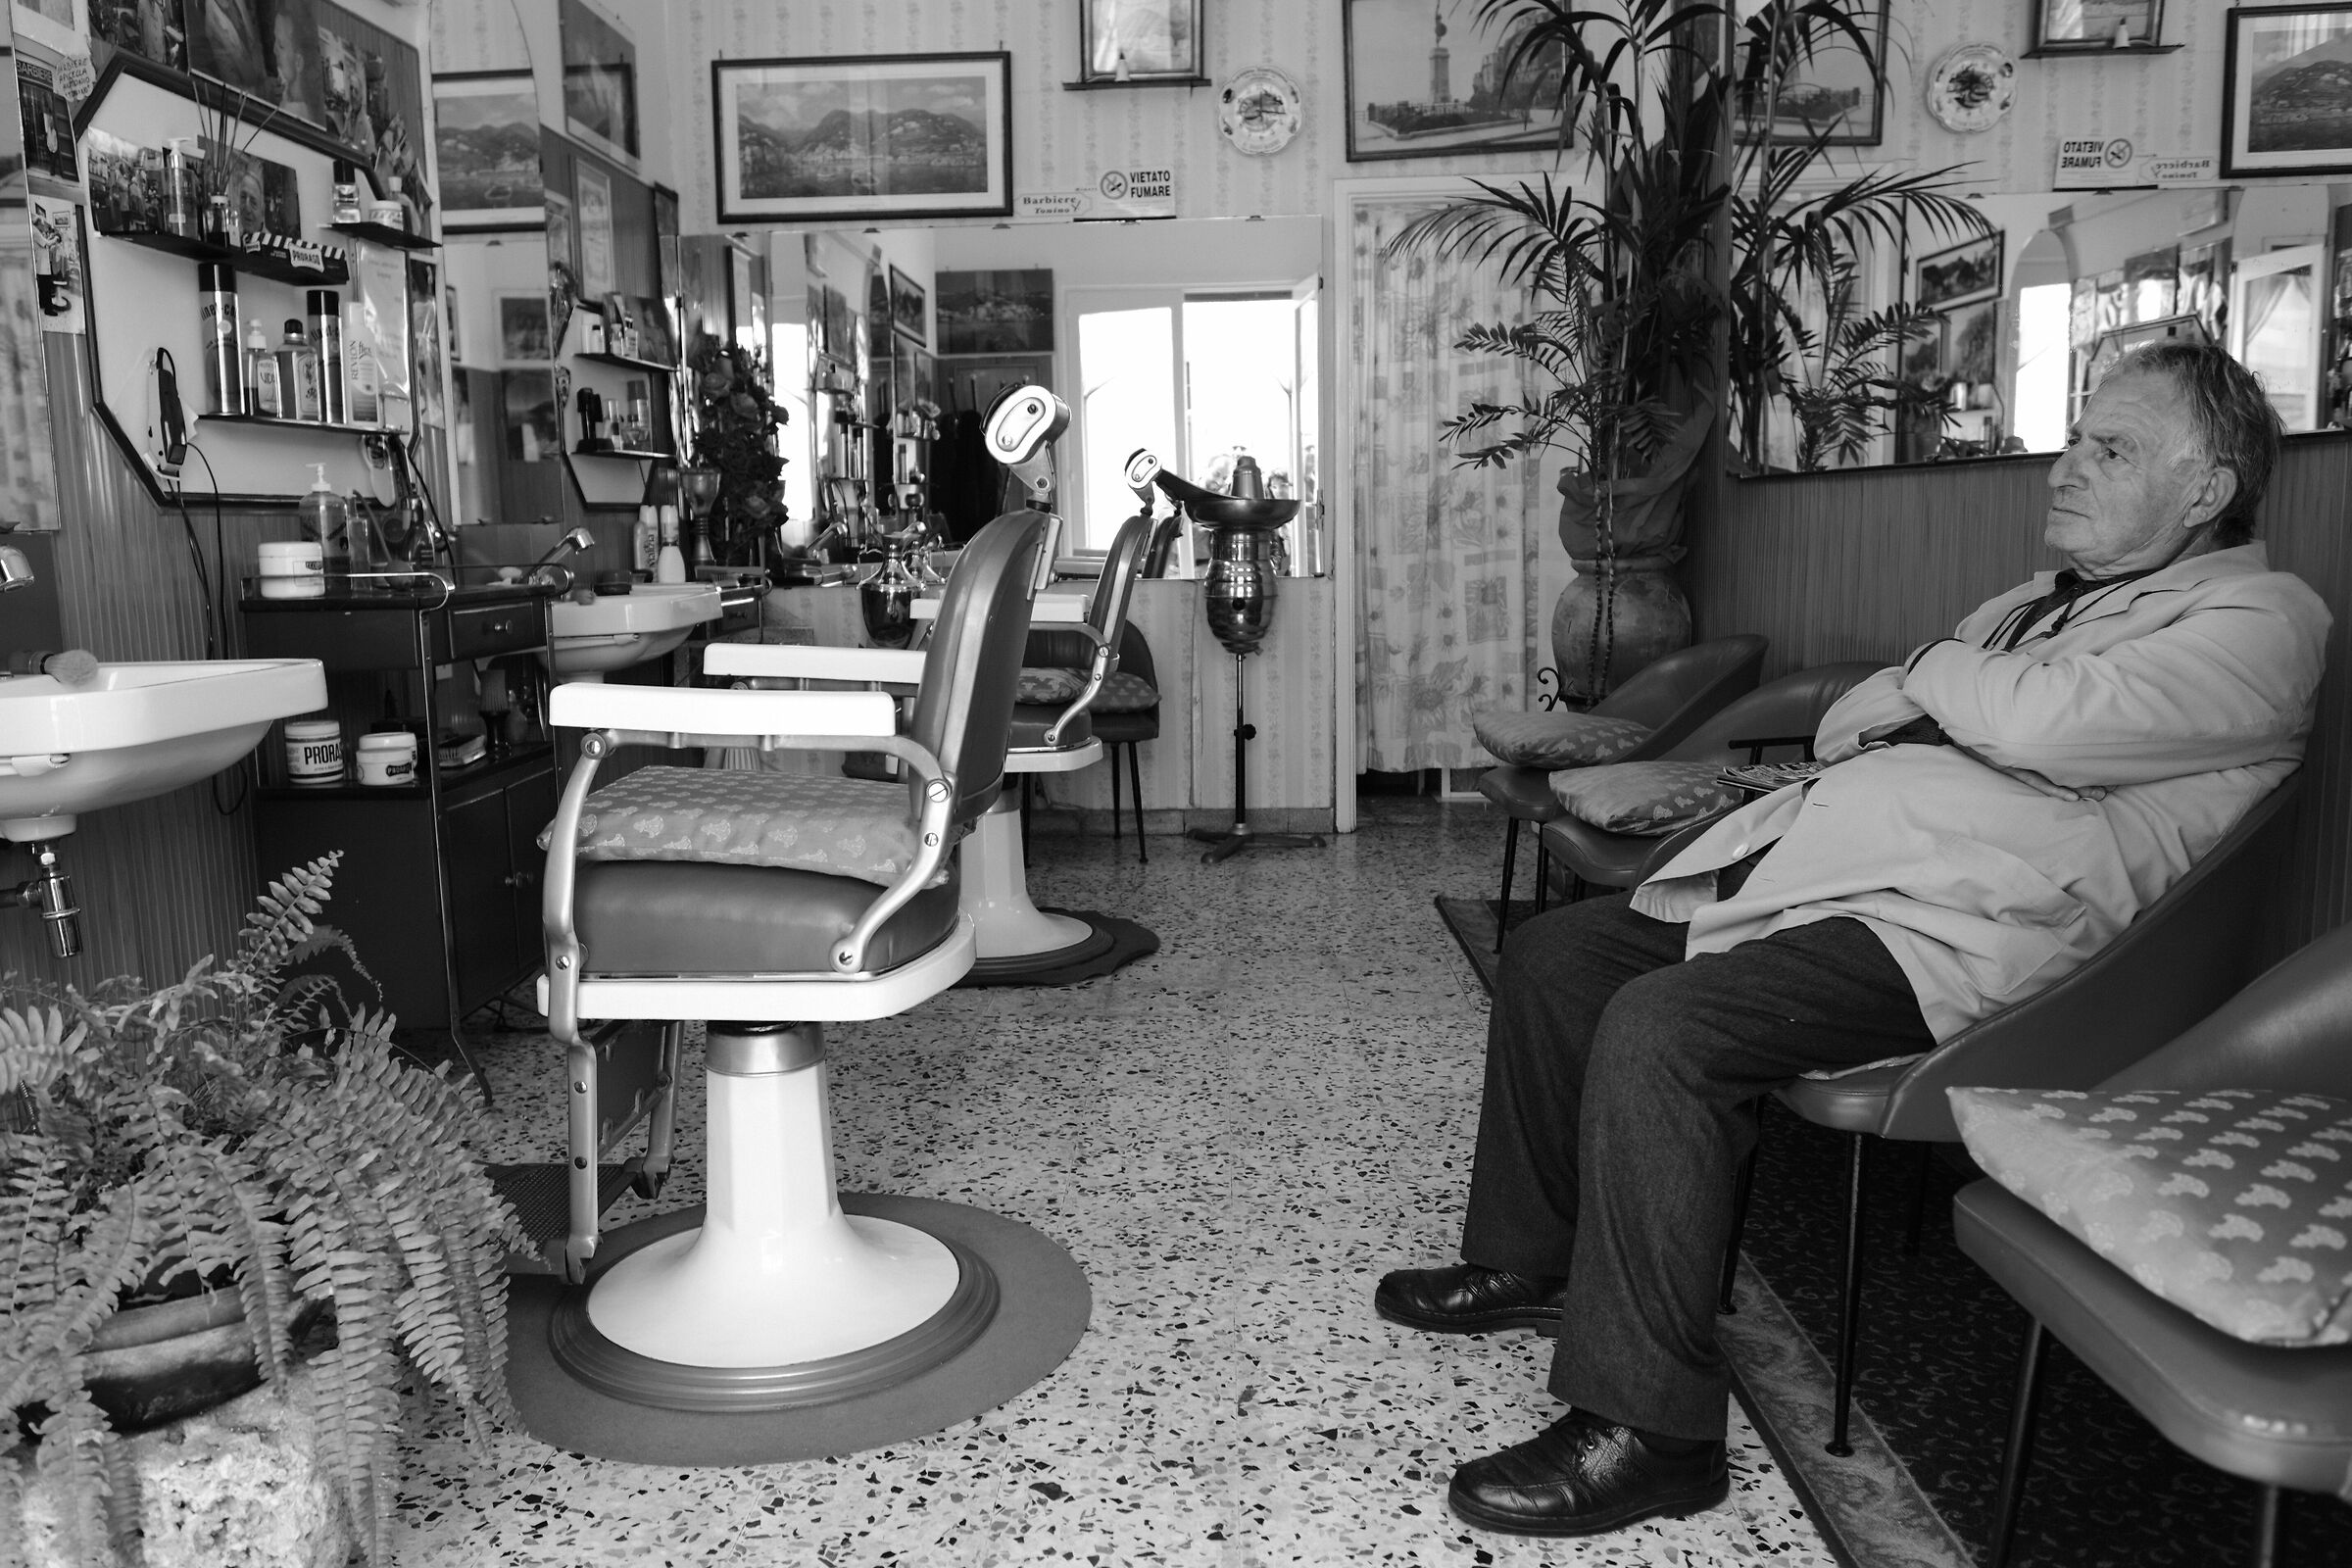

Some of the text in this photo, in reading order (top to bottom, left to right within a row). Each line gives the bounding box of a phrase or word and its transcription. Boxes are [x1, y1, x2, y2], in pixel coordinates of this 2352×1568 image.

[1130, 171, 1171, 183] VIETATO
[1131, 185, 1171, 198] FUMARE
[1023, 195, 1077, 205] Barbiere
[293, 249, 320, 266] PRORASO
[349, 340, 359, 380] REVLON
[304, 743, 341, 765] PRORA
